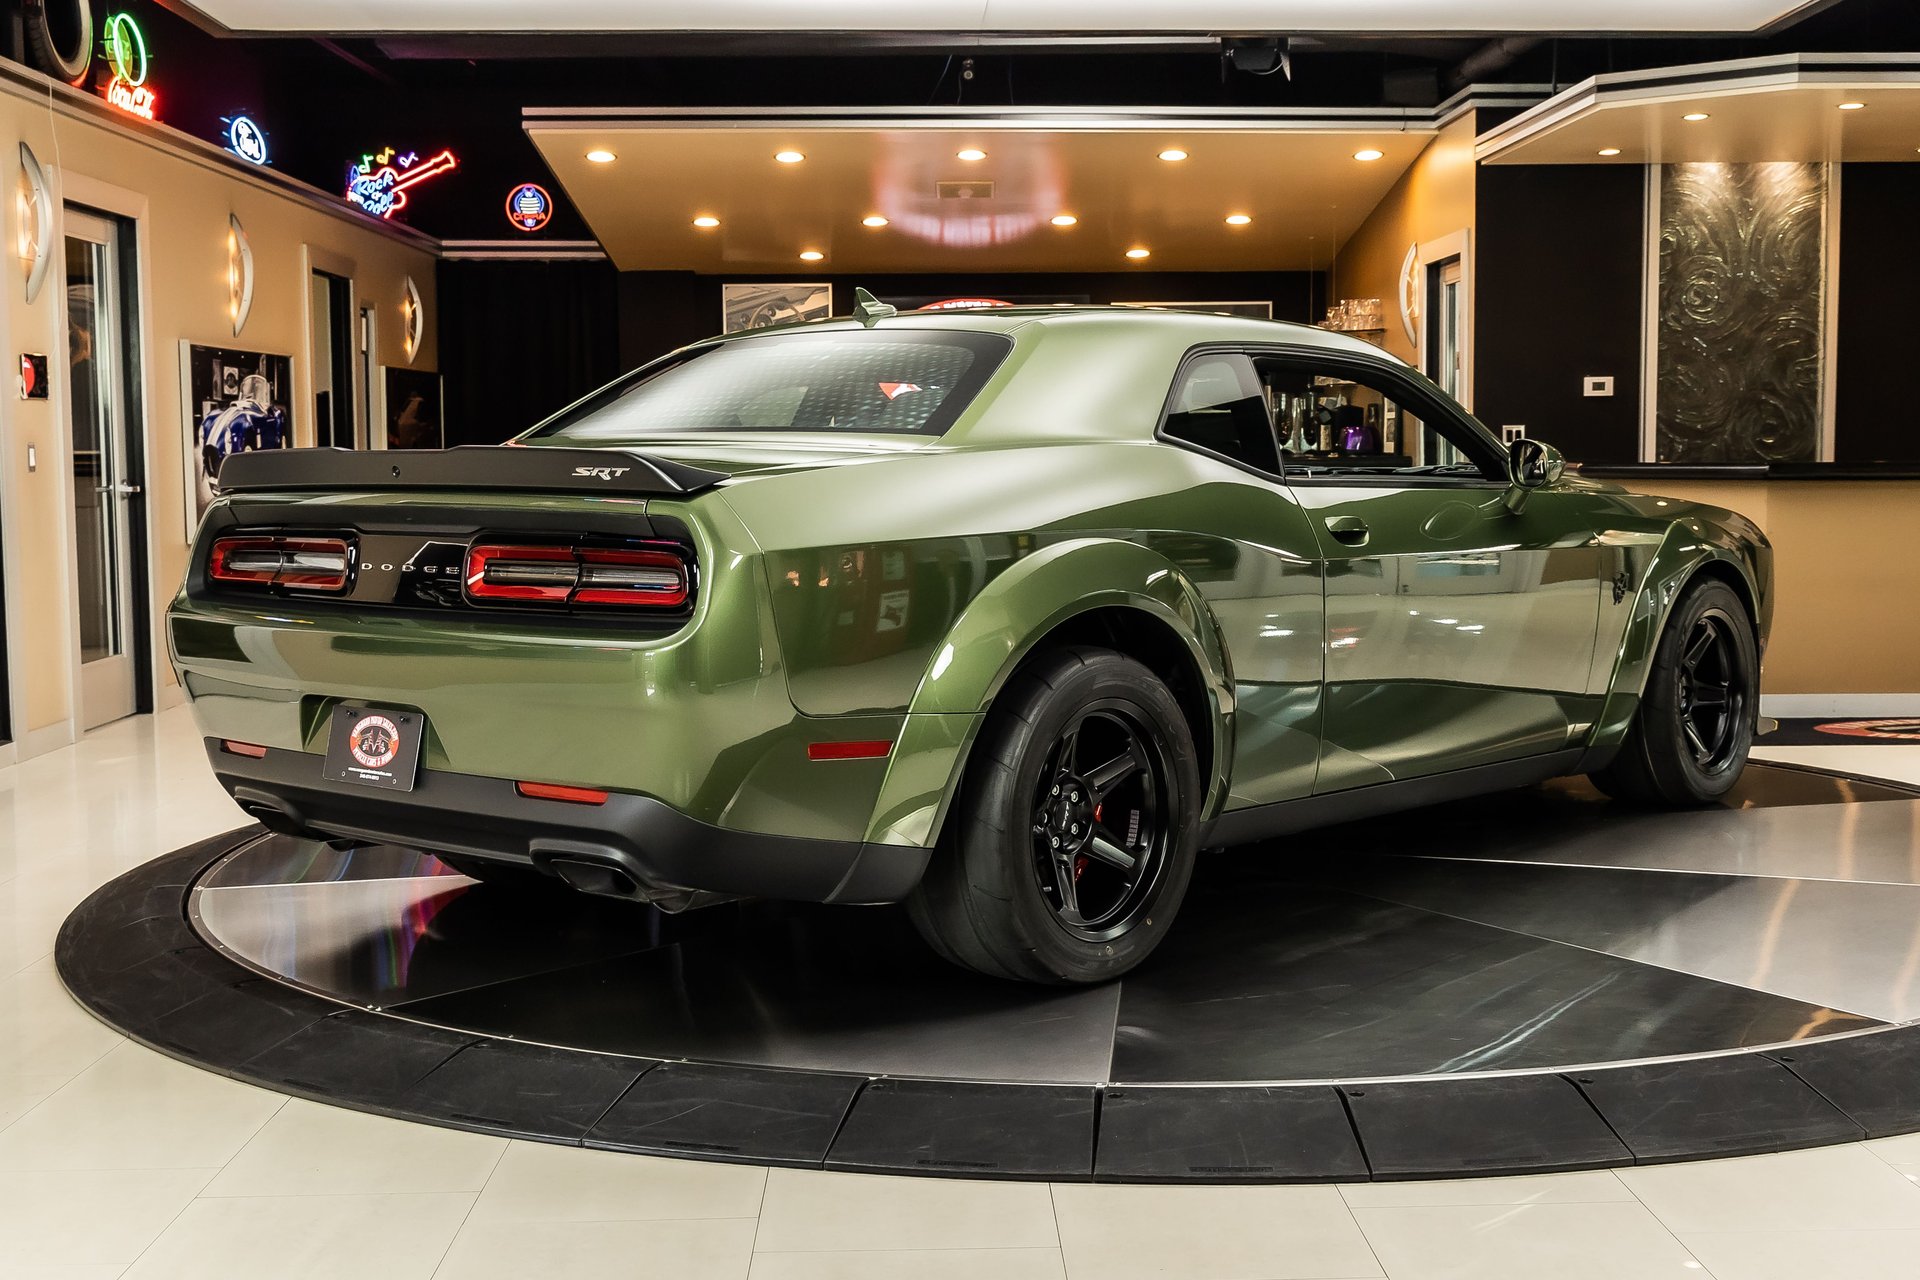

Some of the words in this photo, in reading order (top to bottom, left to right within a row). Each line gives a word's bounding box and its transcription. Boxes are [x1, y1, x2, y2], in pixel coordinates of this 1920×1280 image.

[360, 171, 394, 196] Rock
[572, 467, 631, 481] SRT
[361, 563, 460, 575] DODGE
